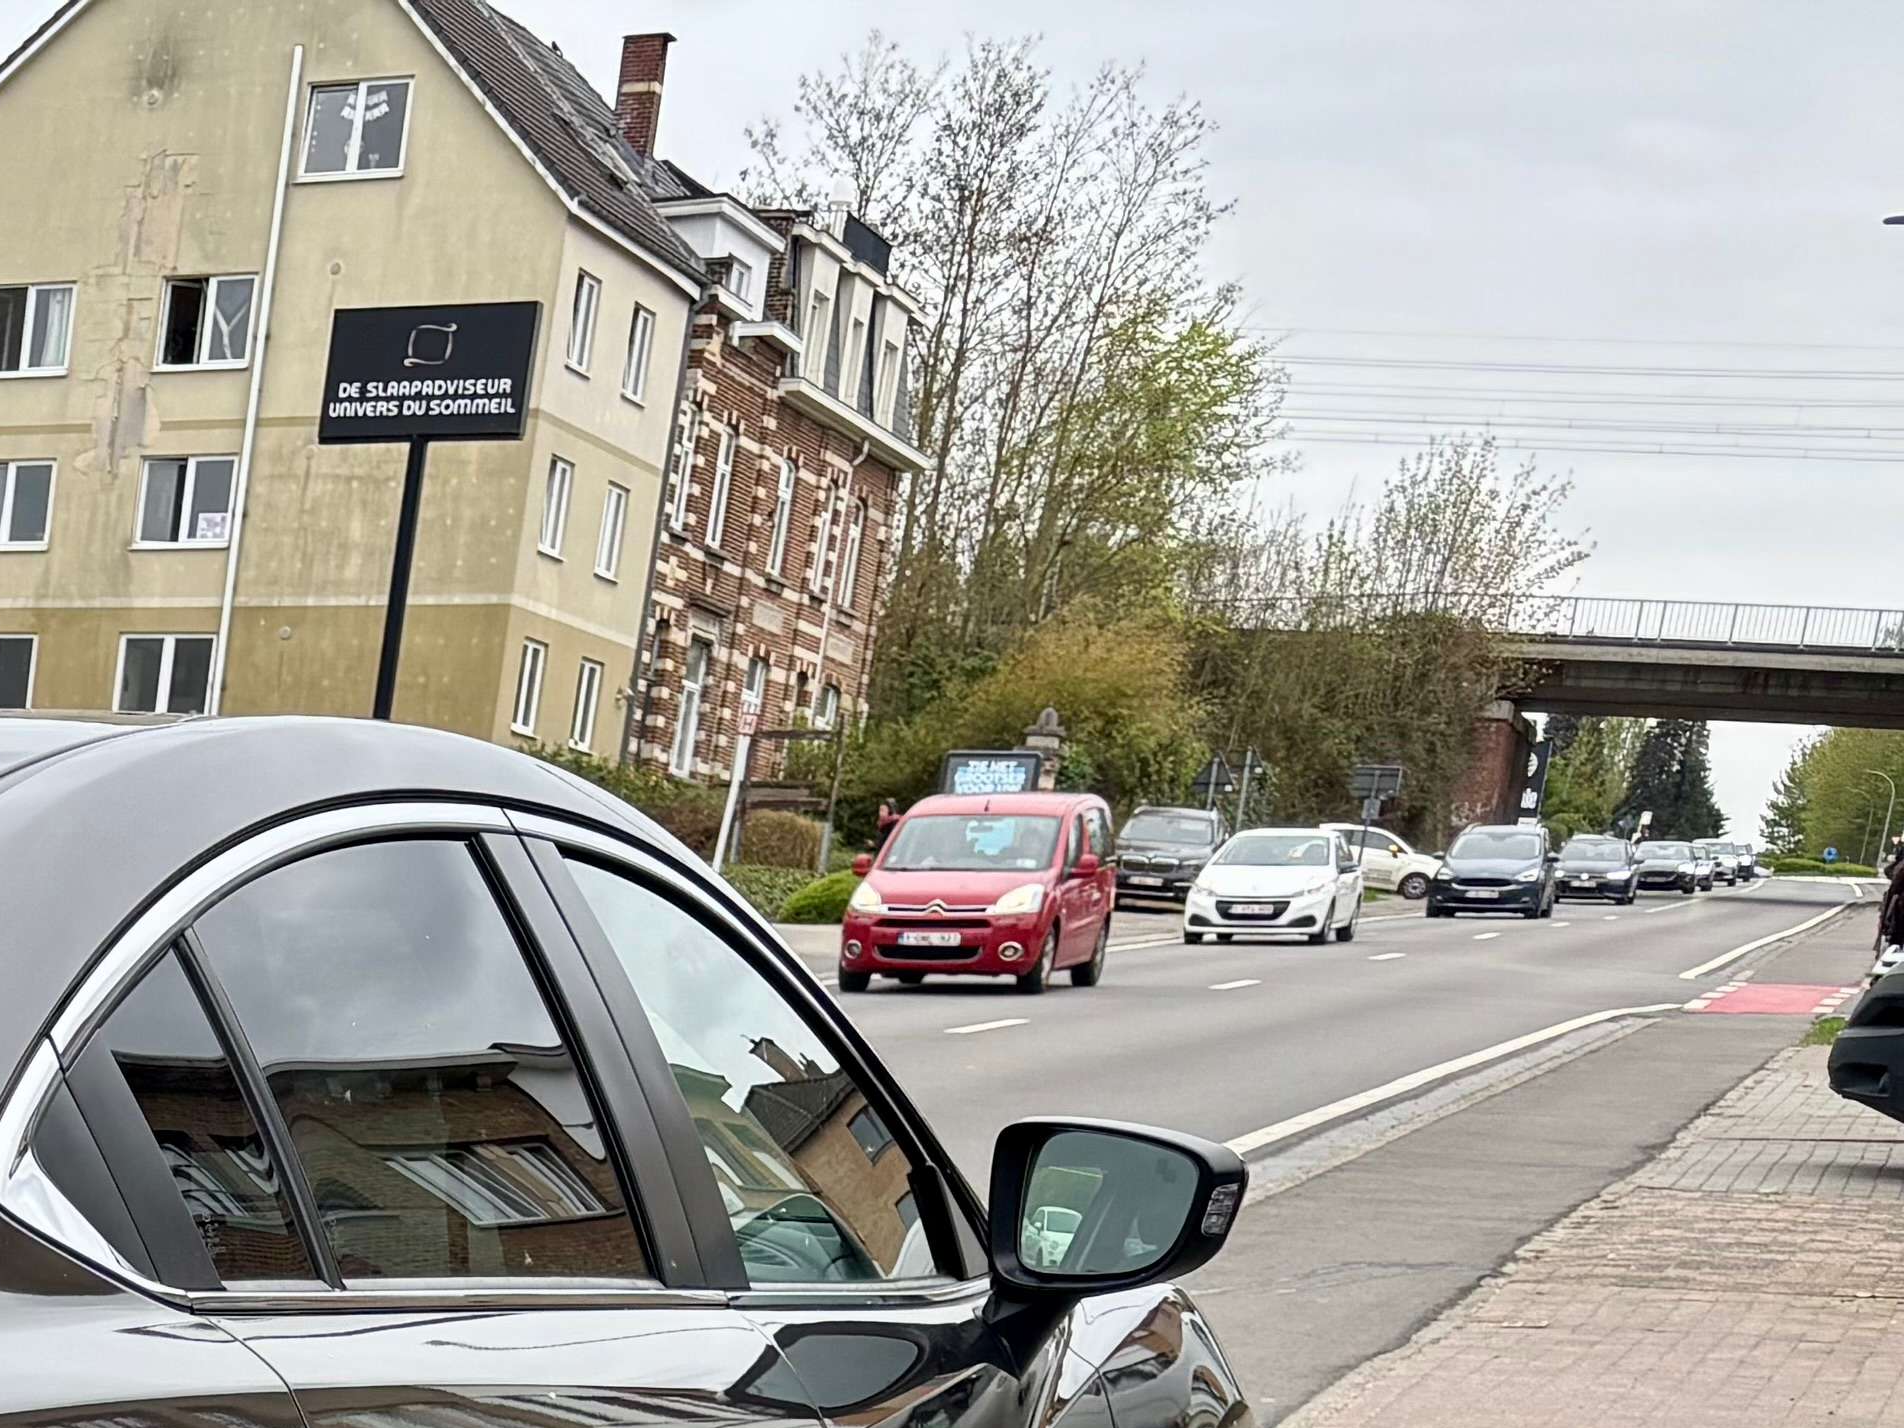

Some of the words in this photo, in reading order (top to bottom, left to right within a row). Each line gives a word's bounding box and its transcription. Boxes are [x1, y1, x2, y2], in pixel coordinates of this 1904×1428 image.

[338, 382, 362, 398] DE
[365, 378, 513, 398] SLAAPADVISEUR
[329, 400, 399, 417] UNIVERS
[402, 400, 427, 416] DU
[429, 397, 516, 415] SOMMEIL
